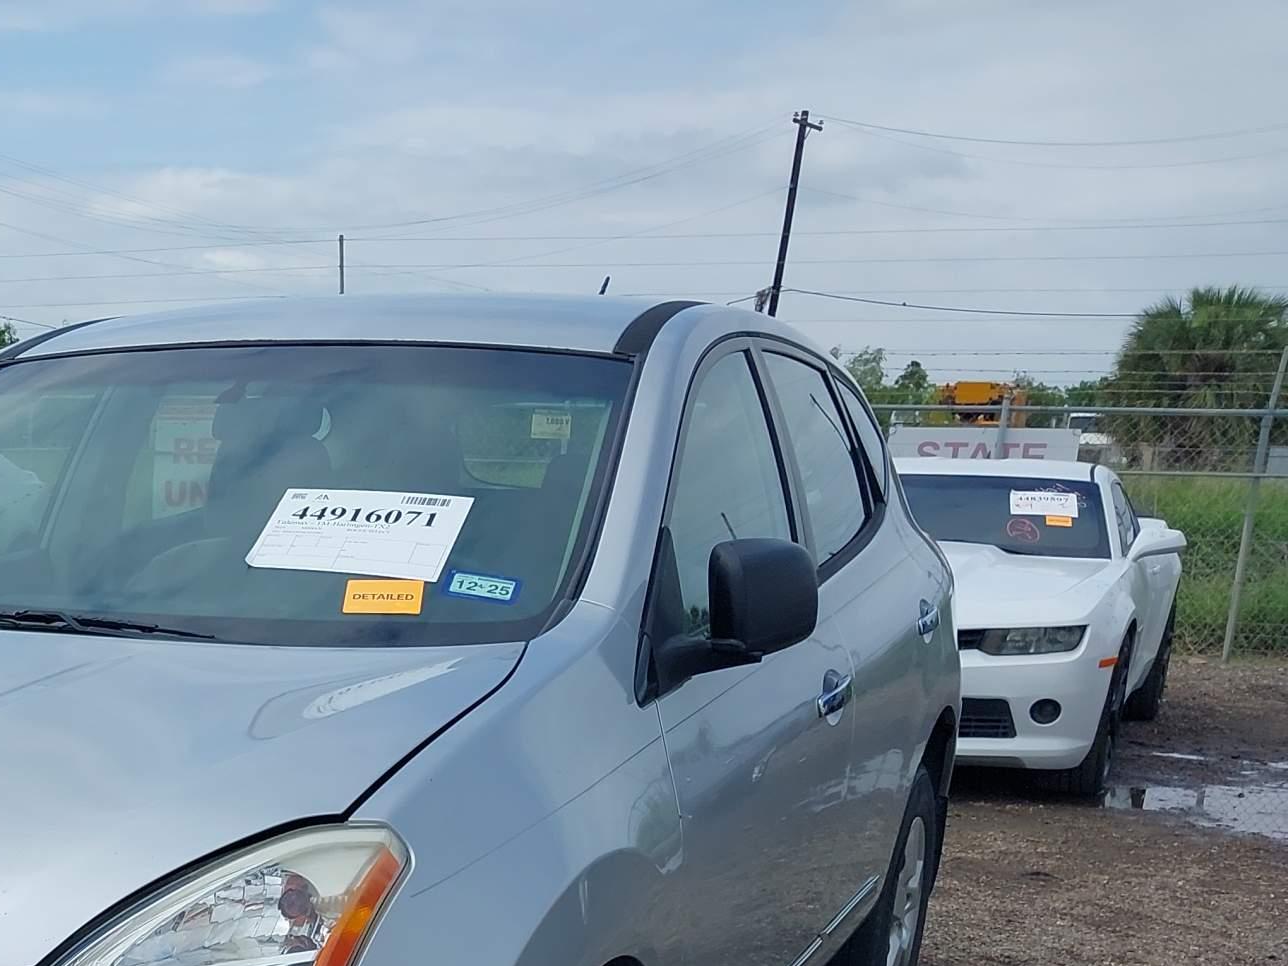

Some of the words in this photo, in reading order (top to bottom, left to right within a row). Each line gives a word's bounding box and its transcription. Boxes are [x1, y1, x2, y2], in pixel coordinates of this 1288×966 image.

[291, 505, 438, 528] 44916071
[352, 593, 415, 601] DETAILED
[486, 584, 511, 597] 25
